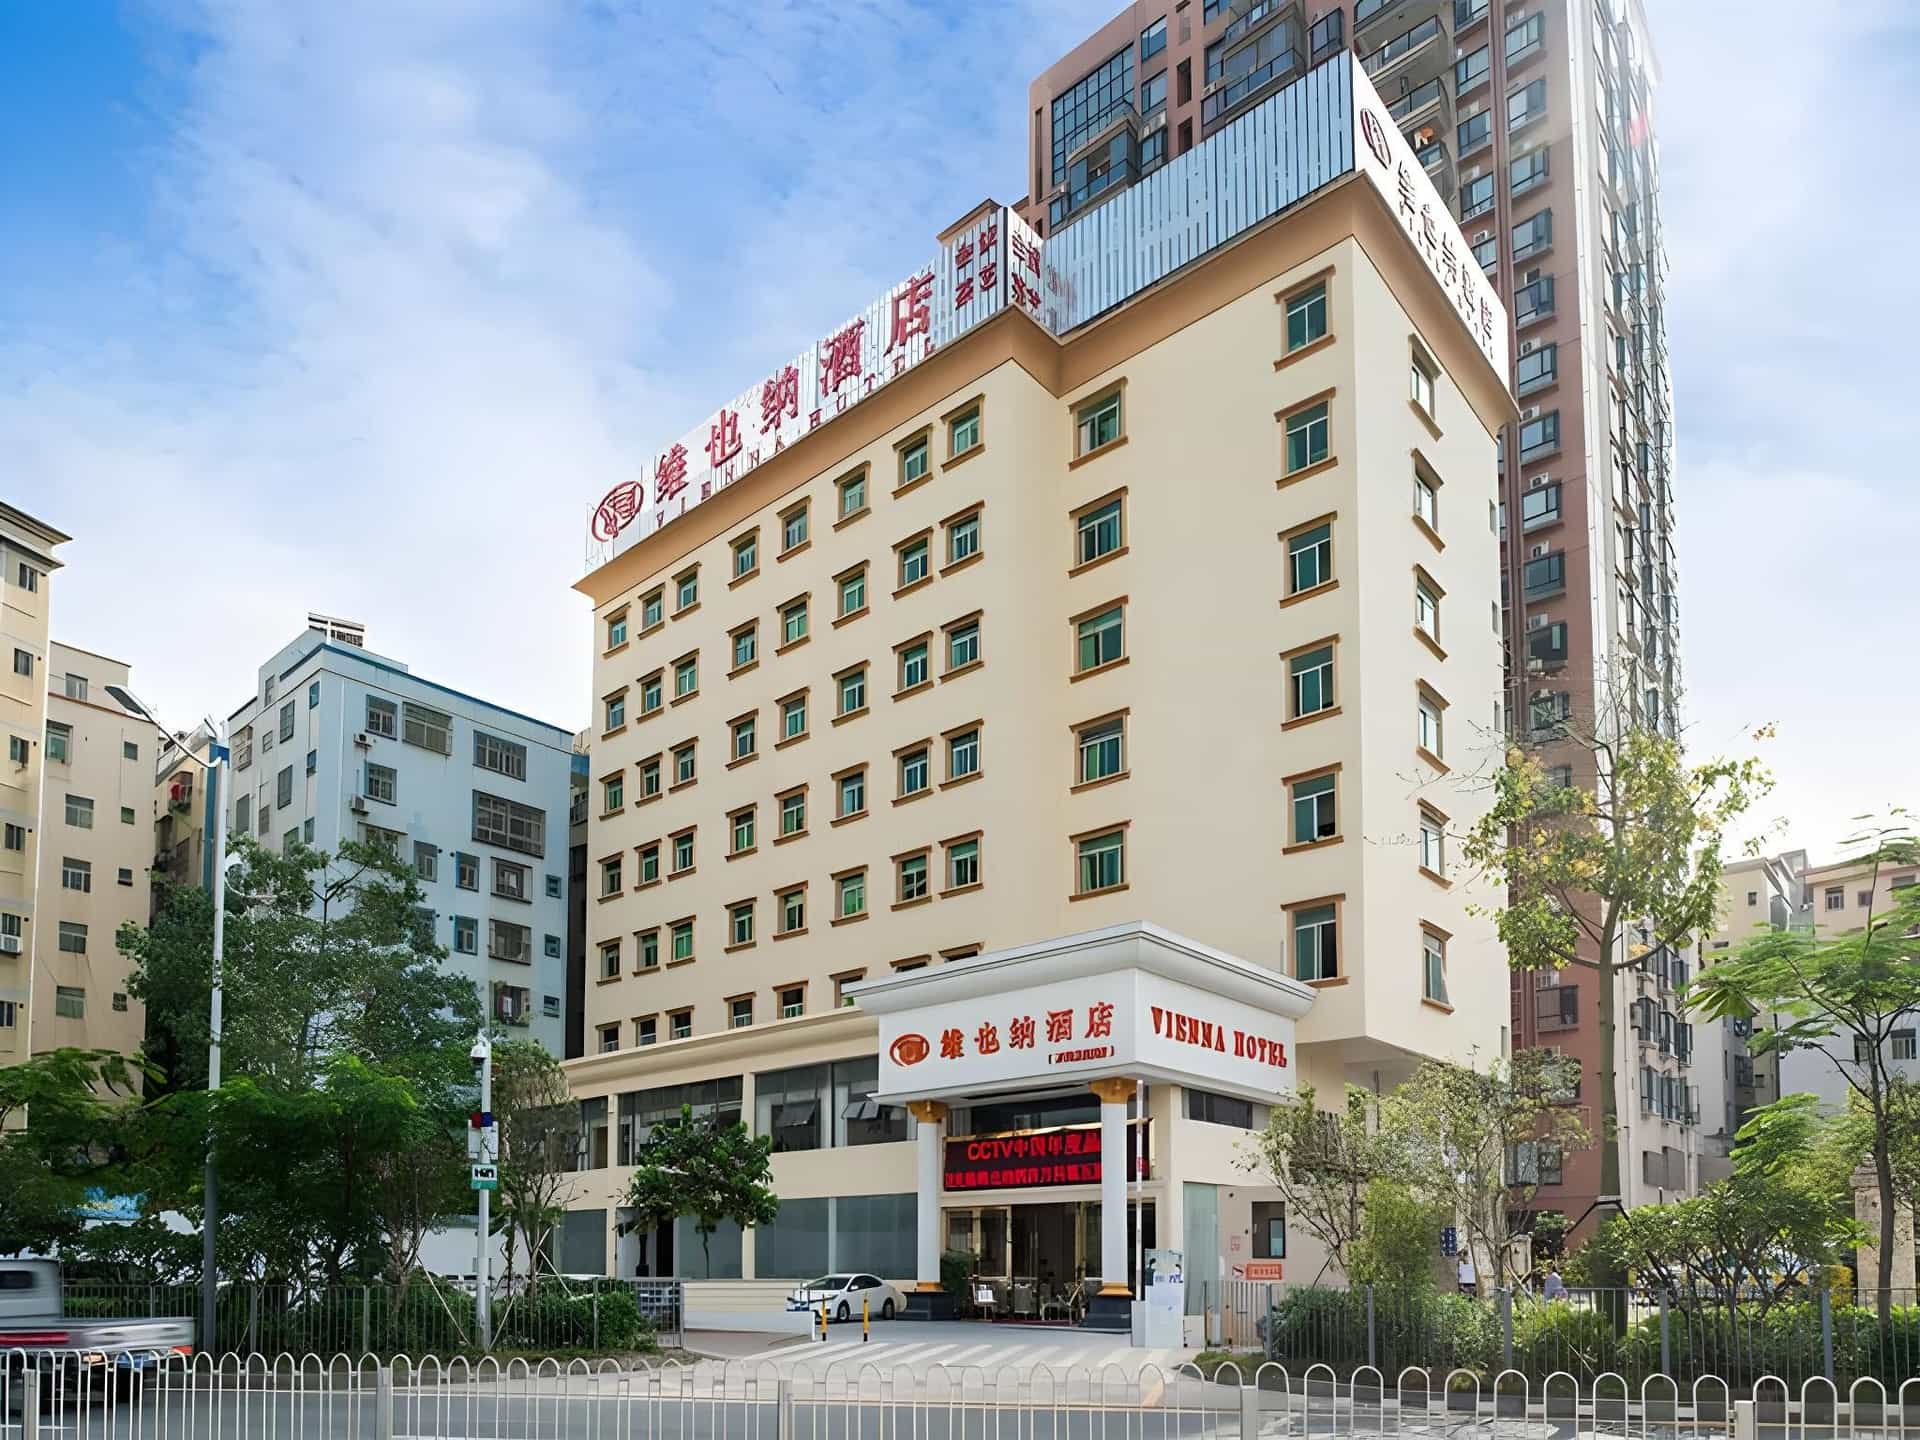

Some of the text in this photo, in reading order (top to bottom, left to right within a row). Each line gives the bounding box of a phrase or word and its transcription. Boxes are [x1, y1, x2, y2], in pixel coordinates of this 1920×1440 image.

[656, 271, 935, 504] 维也纳酒店
[939, 1001, 1115, 1060] 维也纳酒店
[1150, 1006, 1288, 1068] VIENNA HOTEL
